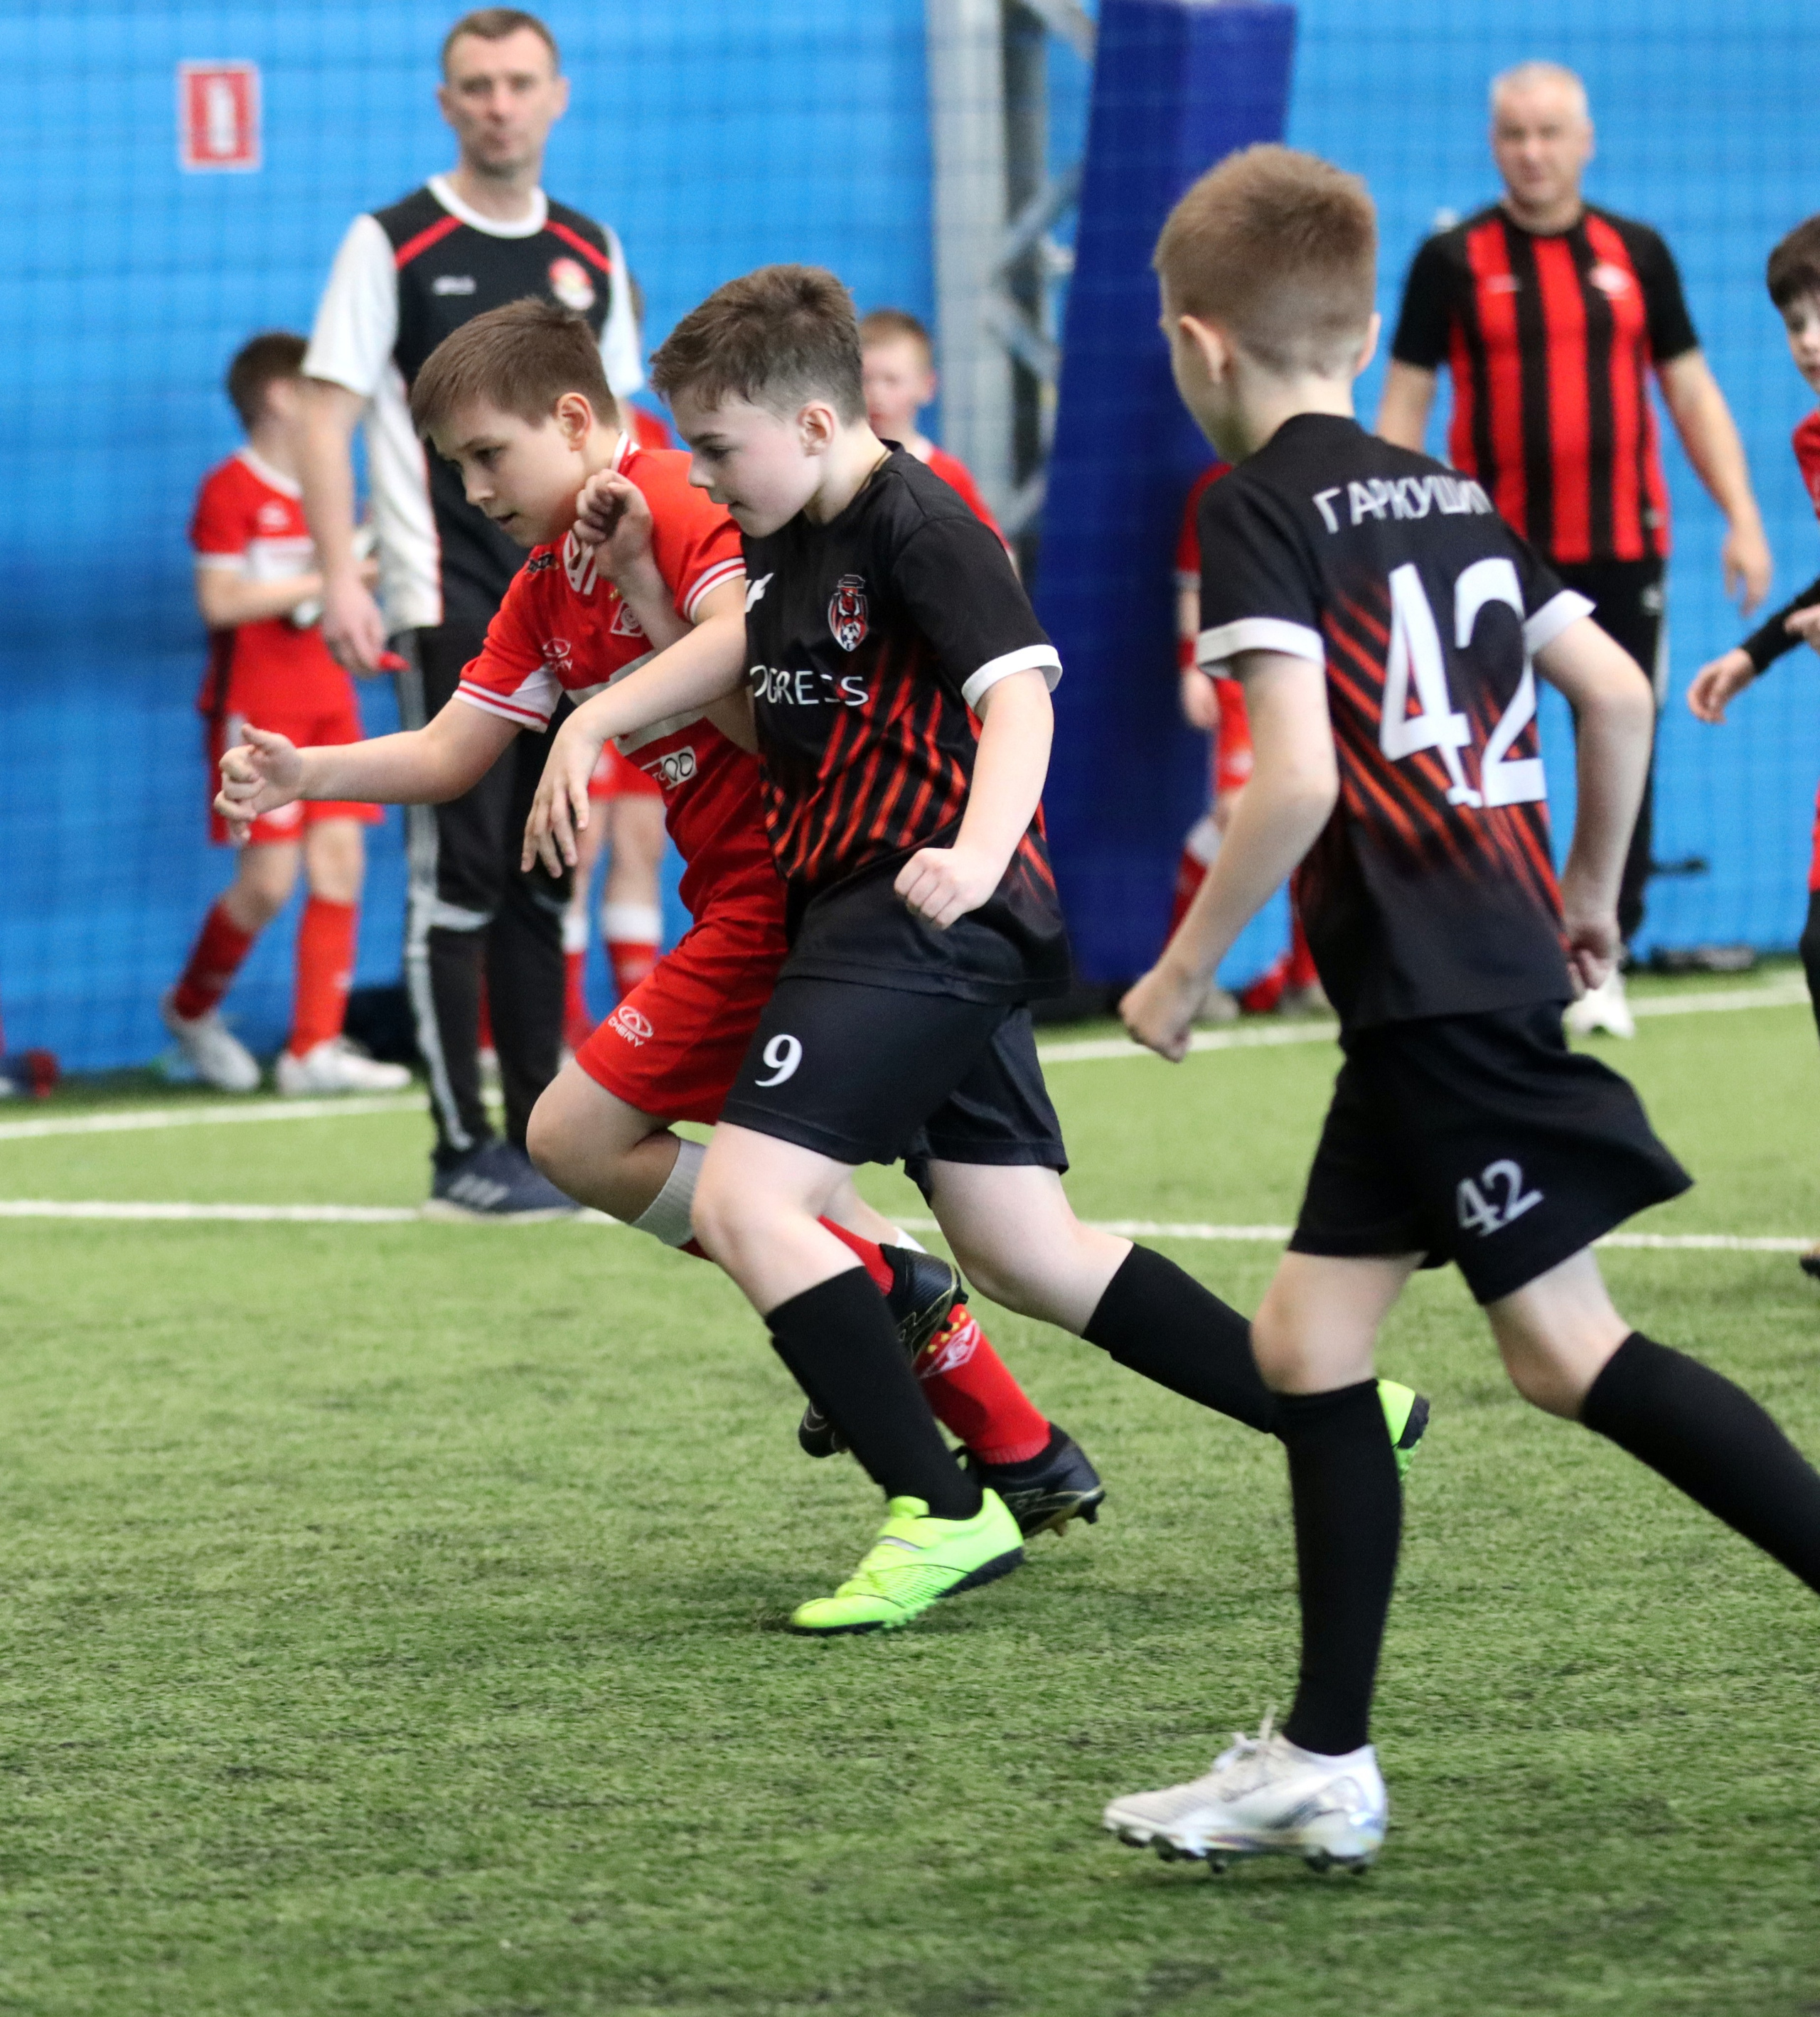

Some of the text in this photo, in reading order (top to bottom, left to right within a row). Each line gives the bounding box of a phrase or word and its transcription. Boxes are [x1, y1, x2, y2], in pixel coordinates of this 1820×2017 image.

[1380, 558, 1547, 808] 42
[607, 1015, 644, 1048] CHERY
[754, 1034, 803, 1087] 9
[1458, 1160, 1544, 1236] 42
